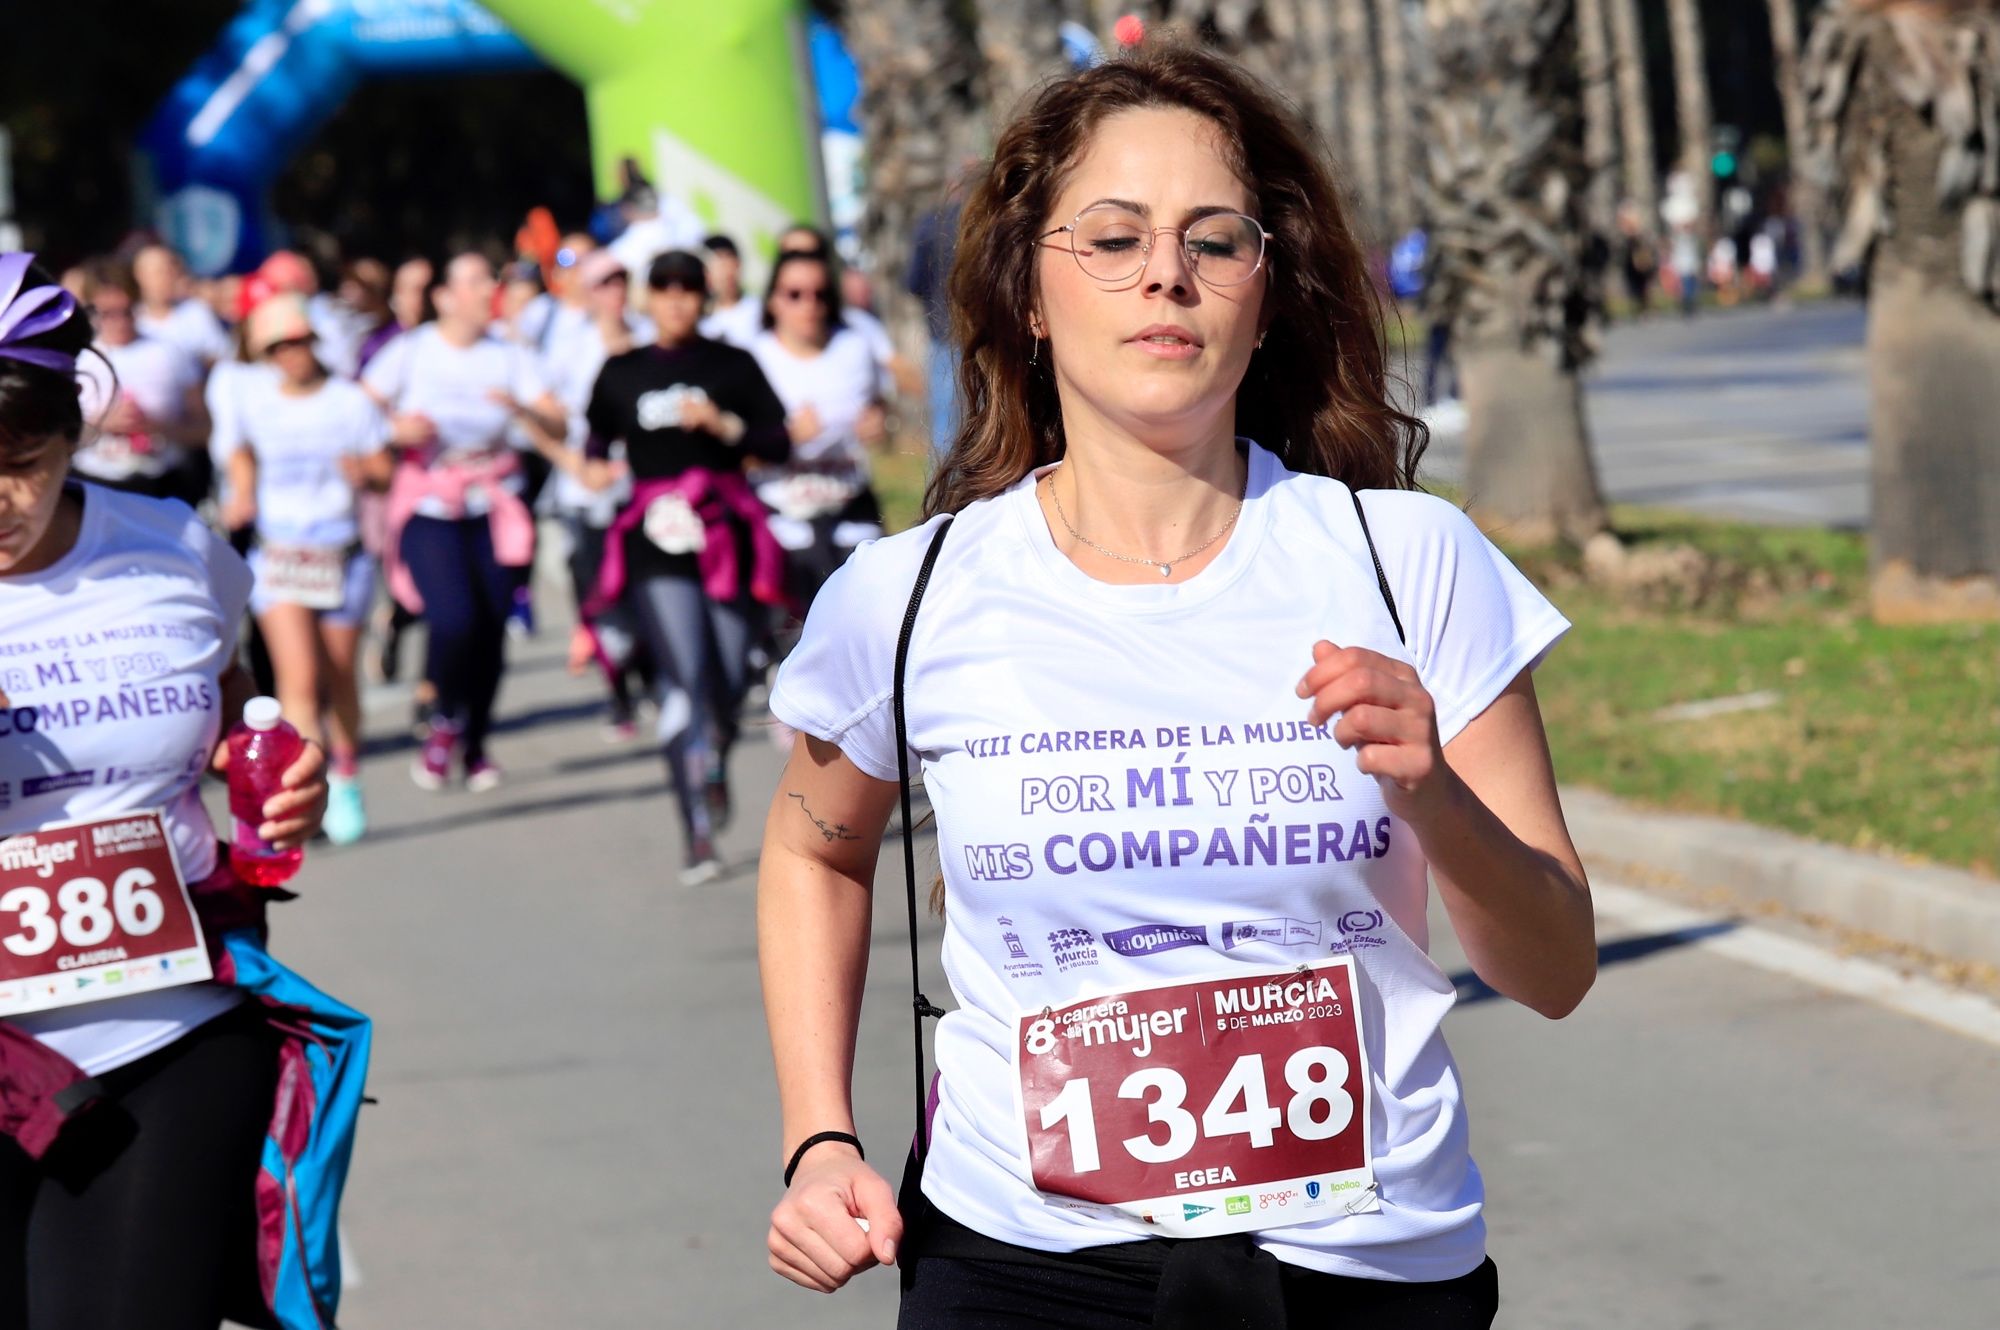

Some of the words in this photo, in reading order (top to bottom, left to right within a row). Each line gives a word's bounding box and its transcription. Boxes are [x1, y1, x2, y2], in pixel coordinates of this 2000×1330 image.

[46, 637, 69, 650] DE
[75, 632, 98, 647] LA
[102, 624, 159, 641] MUJER
[35, 652, 82, 688] MÍ
[965, 735, 1011, 758] VIII
[1020, 729, 1147, 754] CARRERA
[1156, 726, 1191, 748] DE
[1201, 725, 1235, 746] LA
[1243, 721, 1332, 744] MUJER
[1021, 774, 1115, 815] POR
[1126, 752, 1194, 808] MÍ
[1203, 770, 1239, 807] Y
[1248, 764, 1344, 805] POR
[964, 843, 1034, 881] MIS
[1044, 813, 1391, 875] COMPAÑERAS
[1353, 935, 1387, 945] Estado
[56, 945, 128, 971] CLAUDIA
[1055, 947, 1098, 966] Murcia
[1213, 977, 1338, 1015] MURCIA
[1062, 1000, 1129, 1025] carrera
[1217, 1019, 1227, 1031] 5
[1230, 1016, 1249, 1030] DE
[1251, 1010, 1305, 1027] MARZO
[1307, 1004, 1343, 1020] 2023
[1082, 1007, 1188, 1058] mujer
[1039, 1045, 1355, 1172] 1348
[1174, 1166, 1237, 1190] EGEA
